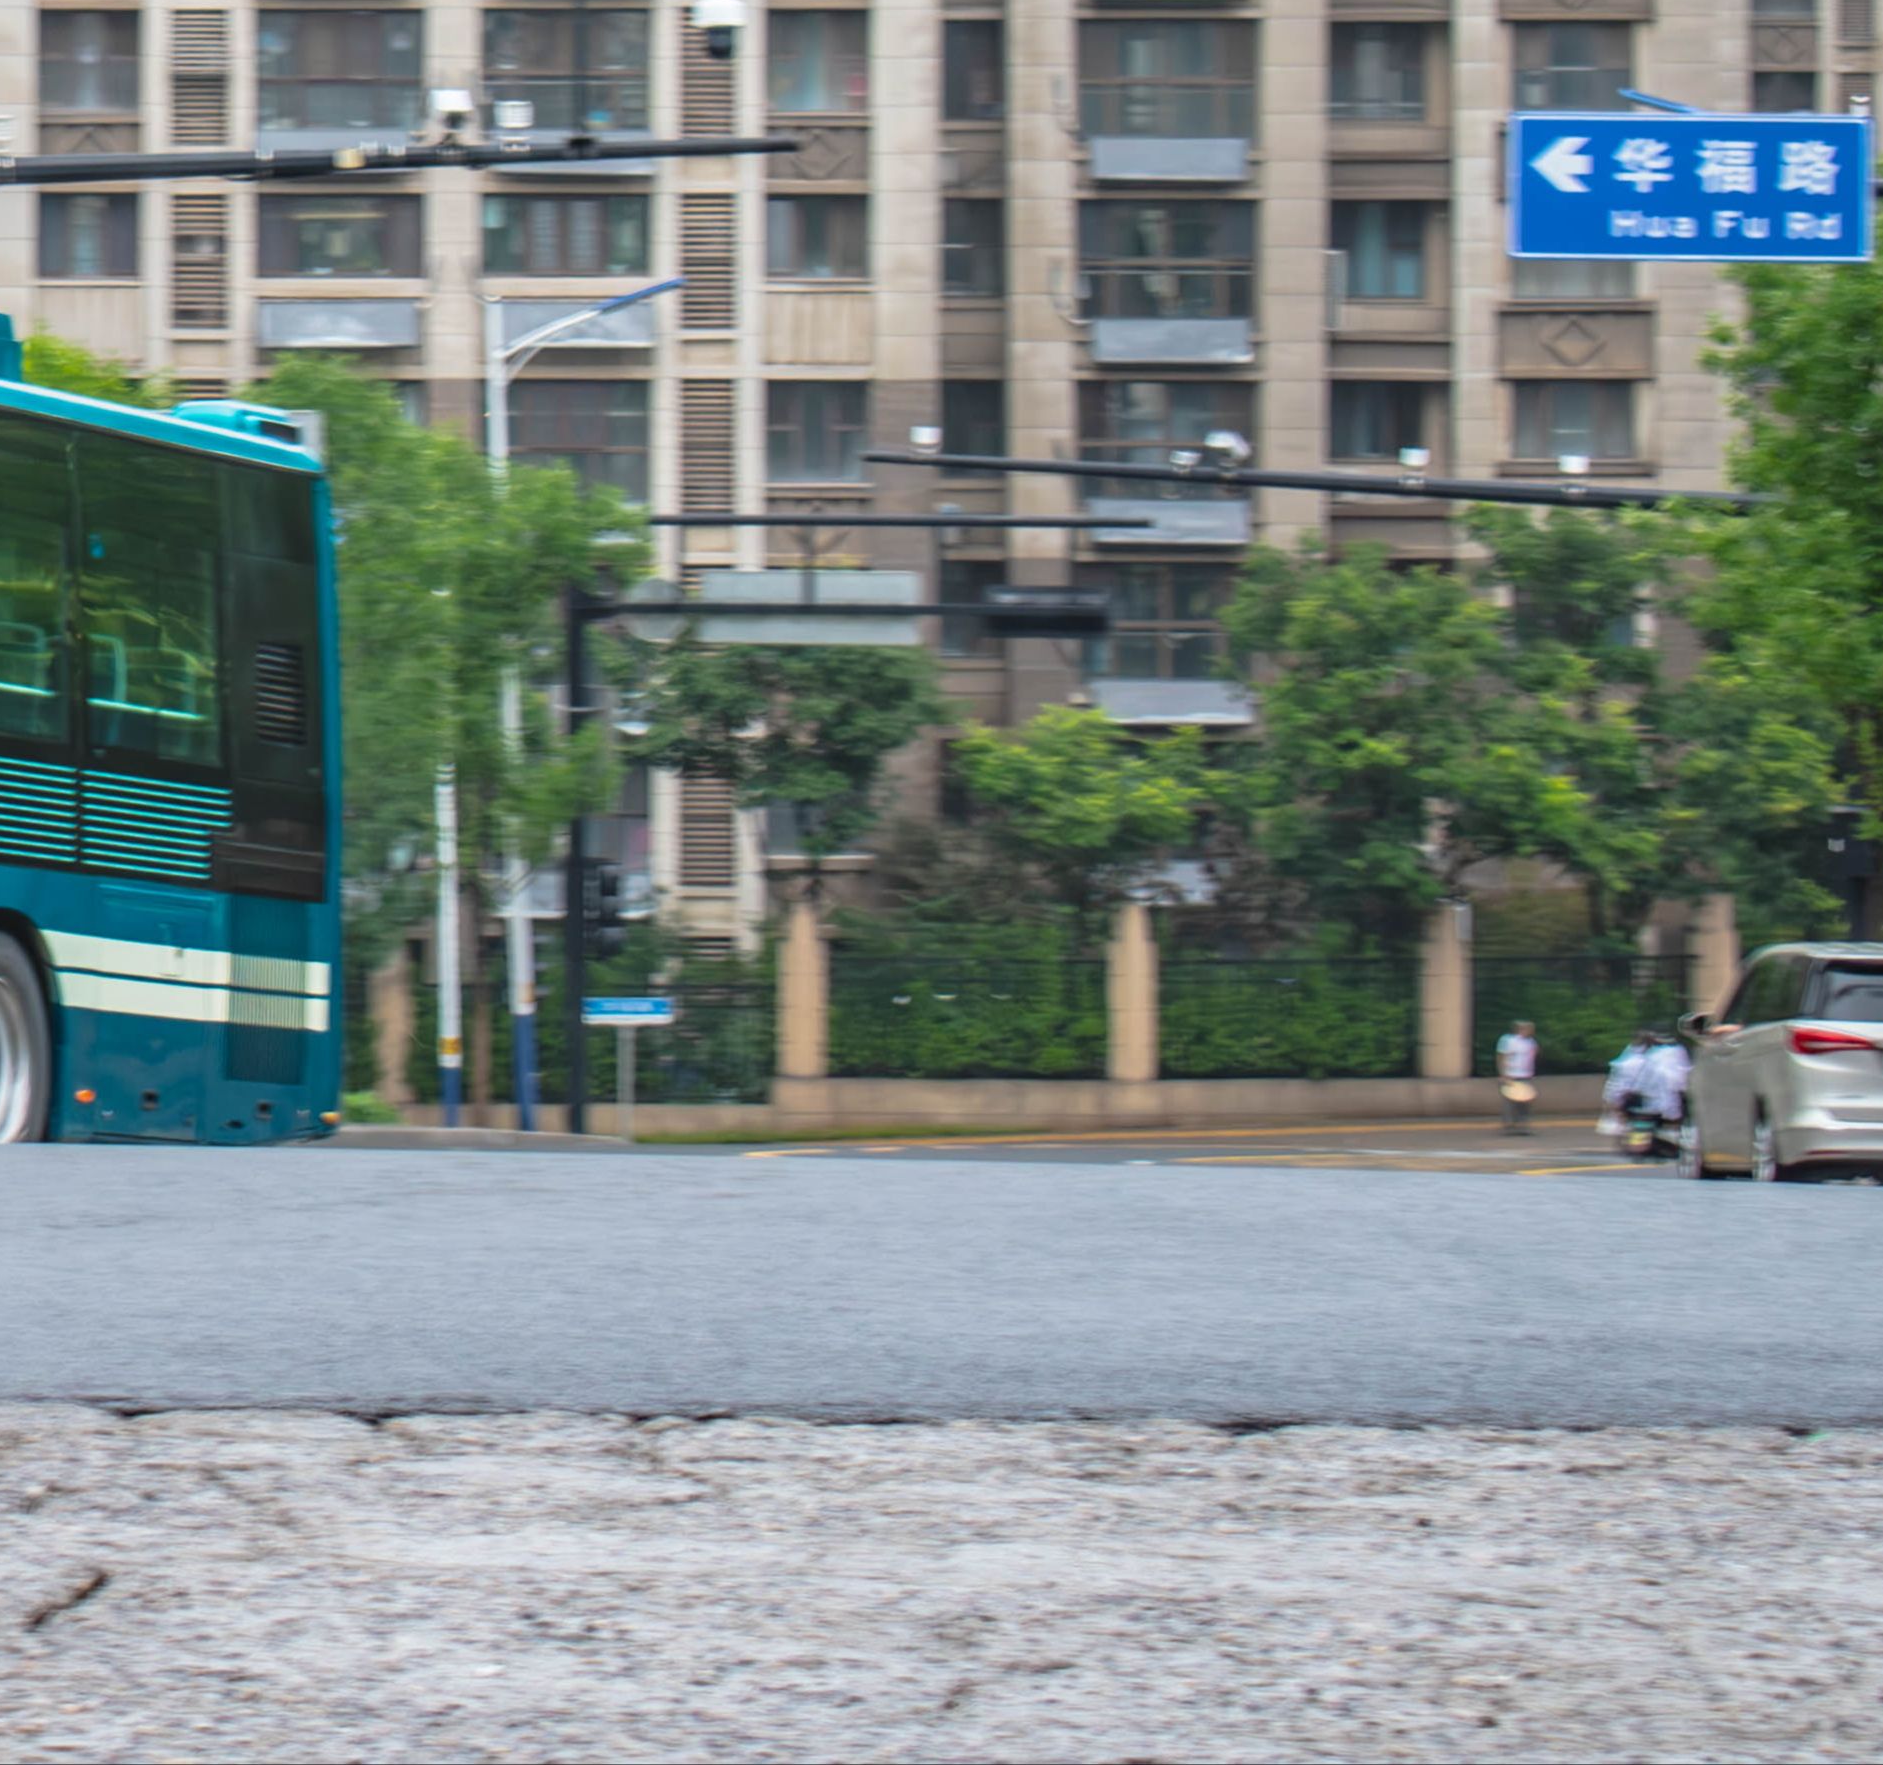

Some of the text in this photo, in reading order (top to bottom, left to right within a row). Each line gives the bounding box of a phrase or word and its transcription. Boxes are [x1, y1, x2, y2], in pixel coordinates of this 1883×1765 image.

[1611, 137, 1840, 195] 华福路
[1608, 209, 1843, 240] Hua Fu Rd
